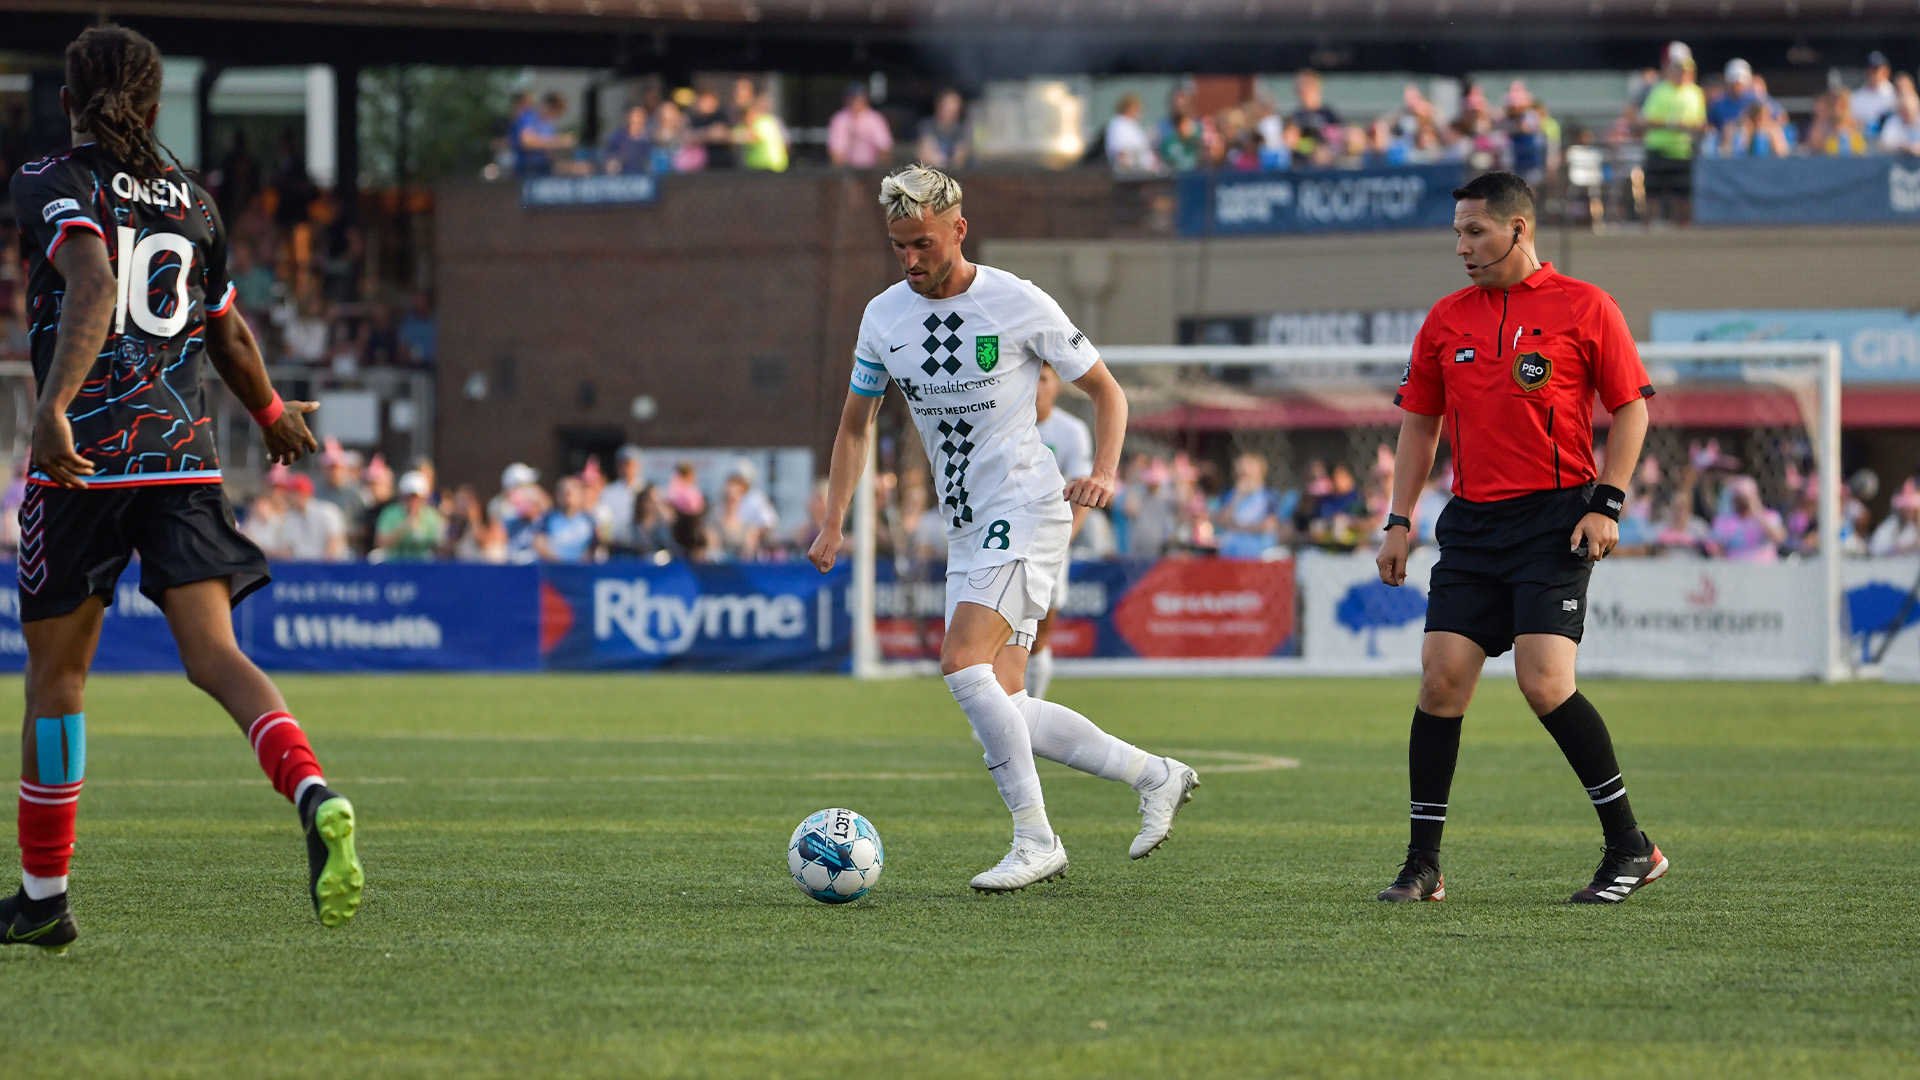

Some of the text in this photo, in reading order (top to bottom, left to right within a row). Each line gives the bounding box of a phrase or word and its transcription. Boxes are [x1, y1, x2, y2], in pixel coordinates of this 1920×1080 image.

[112, 172, 191, 209] ONEN
[115, 225, 194, 337] 10
[1522, 362, 1544, 376] PRO
[922, 377, 995, 396] HealthCare
[944, 400, 997, 416] MEDICINE
[982, 519, 1011, 550] 8
[394, 581, 418, 602] OF
[594, 577, 806, 653] Rhyme
